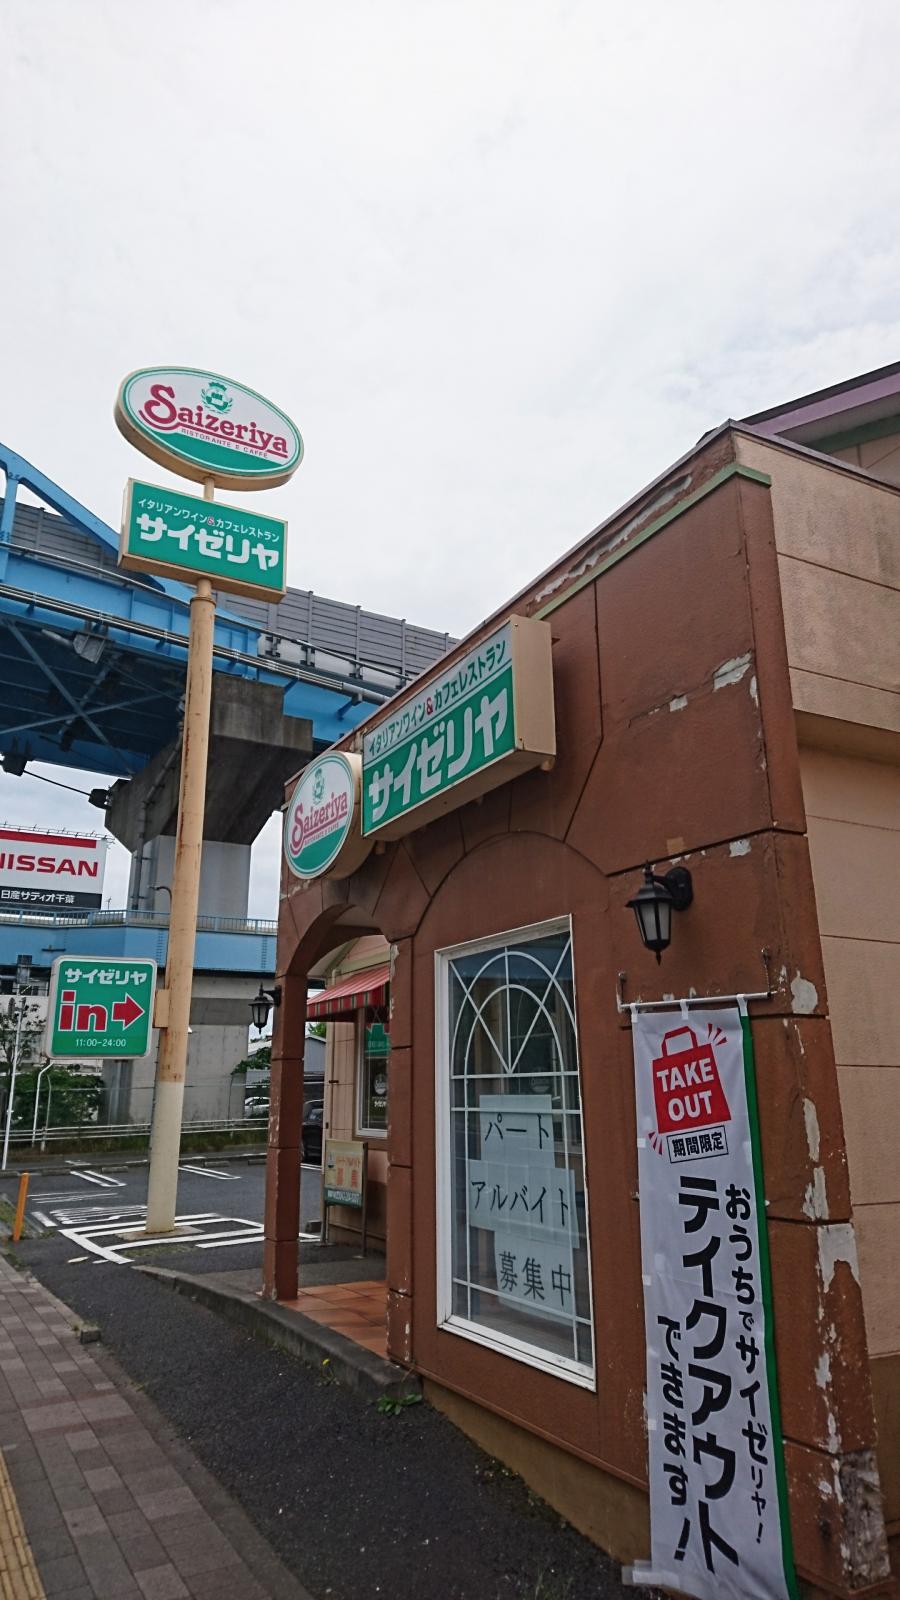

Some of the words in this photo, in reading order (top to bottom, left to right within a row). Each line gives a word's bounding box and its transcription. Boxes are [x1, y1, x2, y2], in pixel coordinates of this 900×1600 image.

[141, 384, 288, 455] Saizeriya
[181, 428, 231, 447] RISTORANTE
[136, 513, 279, 571] サイゼリヤ
[368, 687, 508, 823] サイゼリヤ
[291, 791, 347, 850] Saizeriya
[0, 853, 98, 877] ISSAN
[65, 968, 148, 986] サイゼリヤ
[58, 989, 108, 1032] in
[76, 1038, 127, 1047] 11:00-24:00
[656, 1057, 715, 1093] TAKE
[667, 1090, 713, 1122] OUT
[484, 1113, 550, 1150] パート
[671, 1131, 725, 1158] 期間限定
[471, 1181, 569, 1226] アルバイト
[498, 1250, 572, 1307] 募集中
[678, 1175, 740, 1575] テイクアウト
